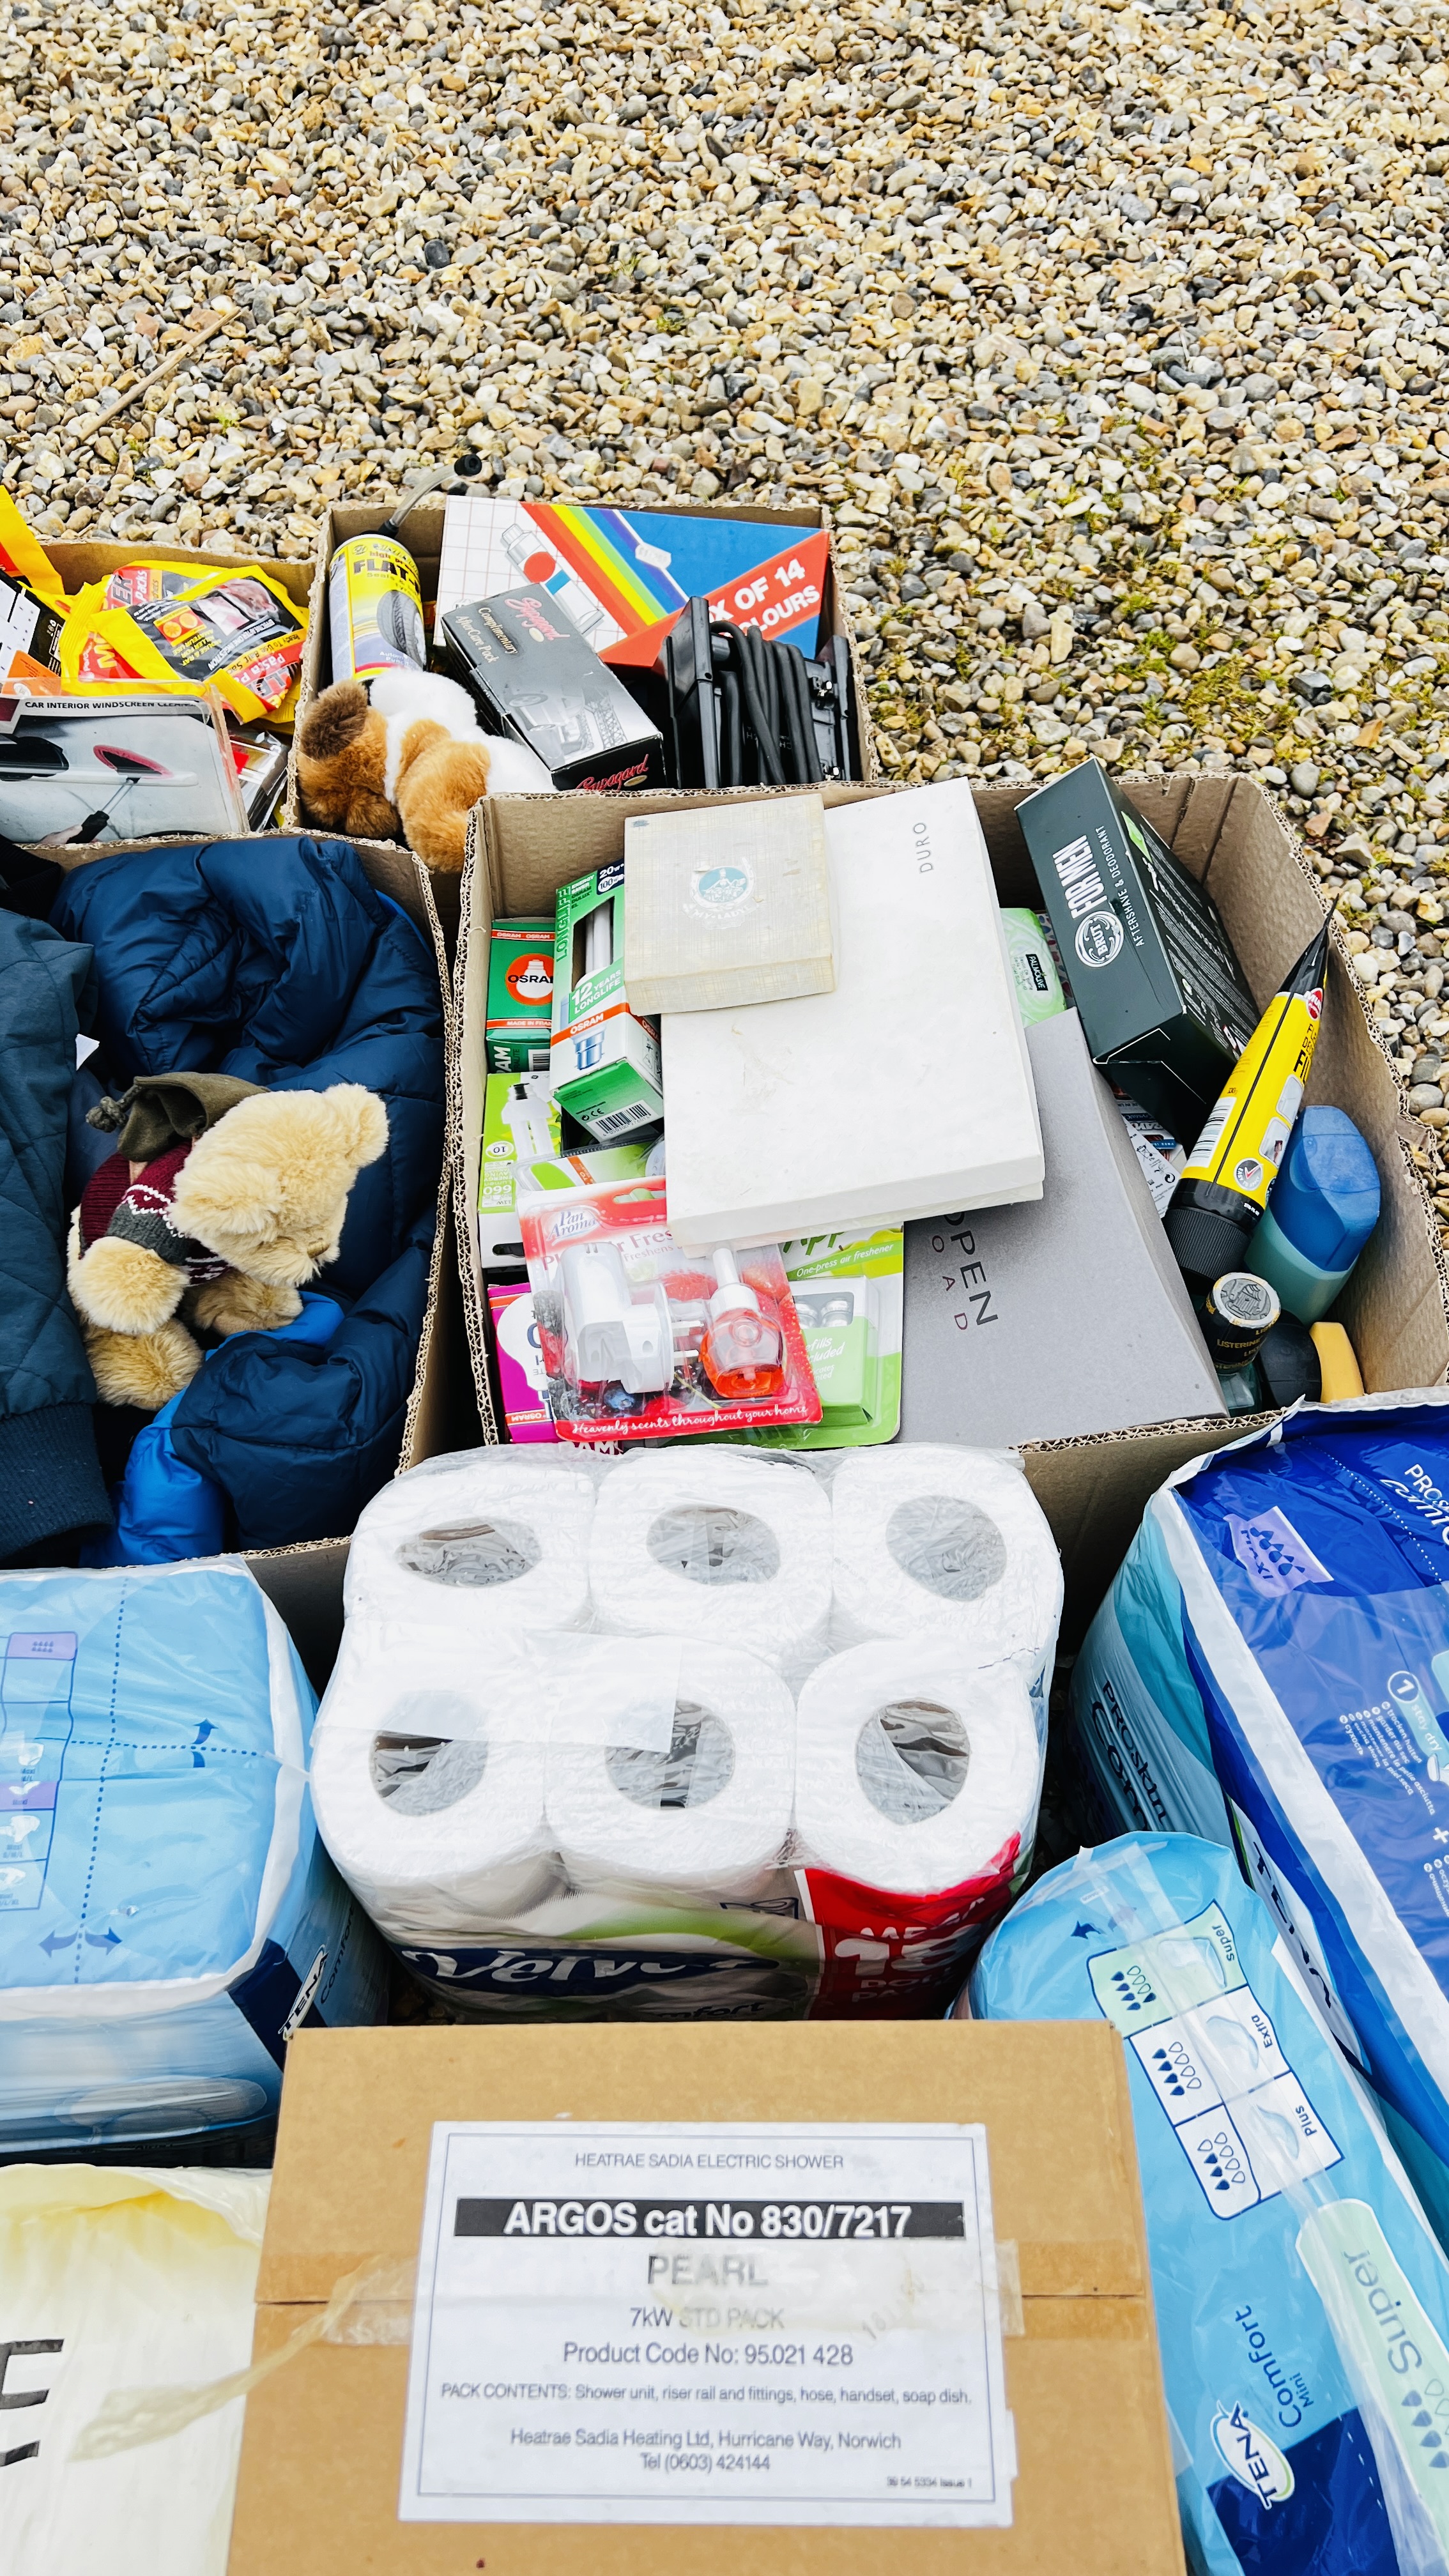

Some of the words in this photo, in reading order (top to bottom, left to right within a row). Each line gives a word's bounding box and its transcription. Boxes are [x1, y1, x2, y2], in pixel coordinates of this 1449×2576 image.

[735, 576, 769, 610] OF
[774, 558, 805, 587] 14
[478, 607, 518, 654] Complimentary
[479, 645, 499, 663] Pack
[914, 823, 933, 873] DURO
[1052, 834, 1097, 887] MEN
[1095, 825, 1121, 879] DEODORANT
[1065, 870, 1108, 919] FOR
[1117, 888, 1145, 947] AFTERSHAVE
[1090, 924, 1110, 956] BRUT
[572, 982, 592, 1006] 12
[594, 969, 621, 992] YEARS
[1029, 956, 1046, 990] PALMOLIVE
[574, 978, 621, 1015] LONGLIFE
[570, 1013, 604, 1034] OSRAM
[483, 1184, 512, 1195] 660
[545, 1218, 597, 1242] Aroma
[560, 1211, 585, 1228] Pan
[624, 1244, 674, 1262] Freshens
[796, 1259, 838, 1278] One-press
[839, 1254, 852, 1264] air
[853, 1243, 894, 1262] freshener
[510, 1412, 542, 1422] OSRAM
[572, 1419, 629, 1436] Heavenly
[631, 1416, 671, 1431] scents
[672, 1408, 744, 1427] throughout
[744, 1407, 774, 1423] your
[774, 1404, 808, 1416] home
[1397, 1678, 1415, 1694] 1
[1411, 1704, 1429, 1731] stay
[1425, 1732, 1443, 1752] dry
[1103, 1680, 1167, 1825] PROskin
[1344, 1724, 1365, 1756] сухость
[1376, 1715, 1397, 1740] garder
[1393, 1740, 1403, 1752] au
[1399, 1751, 1411, 1765] sec
[1387, 1709, 1407, 1740] trocken
[1405, 1738, 1423, 1764] halten
[1360, 1721, 1384, 1758] mantener
[1381, 1758, 1390, 1768] la
[1386, 1767, 1401, 1780] piel
[1398, 1777, 1414, 1796] seca
[1368, 1719, 1396, 1759] mantenere
[1393, 1758, 1401, 1768] la
[1414, 1781, 1436, 1816] asciutta
[1211, 1924, 1236, 1963] Super
[284, 1952, 329, 2030] TENA
[1250, 2014, 1274, 2050] Extra
[1294, 2104, 1318, 2137] Plus
[574, 2152, 645, 2167] HEATRAE
[648, 2153, 694, 2168] SADIA
[697, 2154, 772, 2168] ELECTRIC
[774, 2154, 844, 2168] SHOWER
[503, 2202, 637, 2235] ARGOS
[644, 2205, 698, 2236] cat
[706, 2204, 755, 2237] No
[760, 2205, 912, 2238] 830/7217
[648, 2255, 769, 2286] PEARL
[630, 2307, 673, 2328] 7kW
[678, 2308, 720, 2329] STD
[727, 2308, 786, 2329] PACK
[1344, 2250, 1423, 2375] Super
[564, 2342, 640, 2363] Product
[645, 2342, 700, 2364] Code
[705, 2343, 739, 2365] No:
[744, 2343, 806, 2365] 95.021
[812, 2343, 854, 2365] 428
[441, 2382, 482, 2398] PACK
[484, 2382, 571, 2399] CONTENTS:
[575, 2384, 627, 2399] Shower
[630, 2384, 659, 2402] unit,
[663, 2385, 691, 2400] riser
[696, 2386, 716, 2400] rail
[719, 2386, 746, 2401] and
[748, 2386, 797, 2404] fittings,
[801, 2386, 837, 2404] hose,
[840, 2387, 900, 2404] handset,
[903, 2389, 937, 2405] soap
[940, 2388, 972, 2404] dish.
[1289, 2371, 1314, 2409] Mini
[510, 2428, 572, 2445] Heatrae
[575, 2428, 619, 2446] Sadia
[622, 2430, 682, 2450] Heating
[686, 2430, 714, 2449] Ltd,
[718, 2430, 795, 2448] Hurricane
[798, 2432, 834, 2452] Way,
[838, 2432, 901, 2449] Norwich
[1230, 2404, 1278, 2501] TENA
[640, 2452, 661, 2469] Tel
[665, 2453, 712, 2472] (0603)
[716, 2454, 770, 2470] 424144
